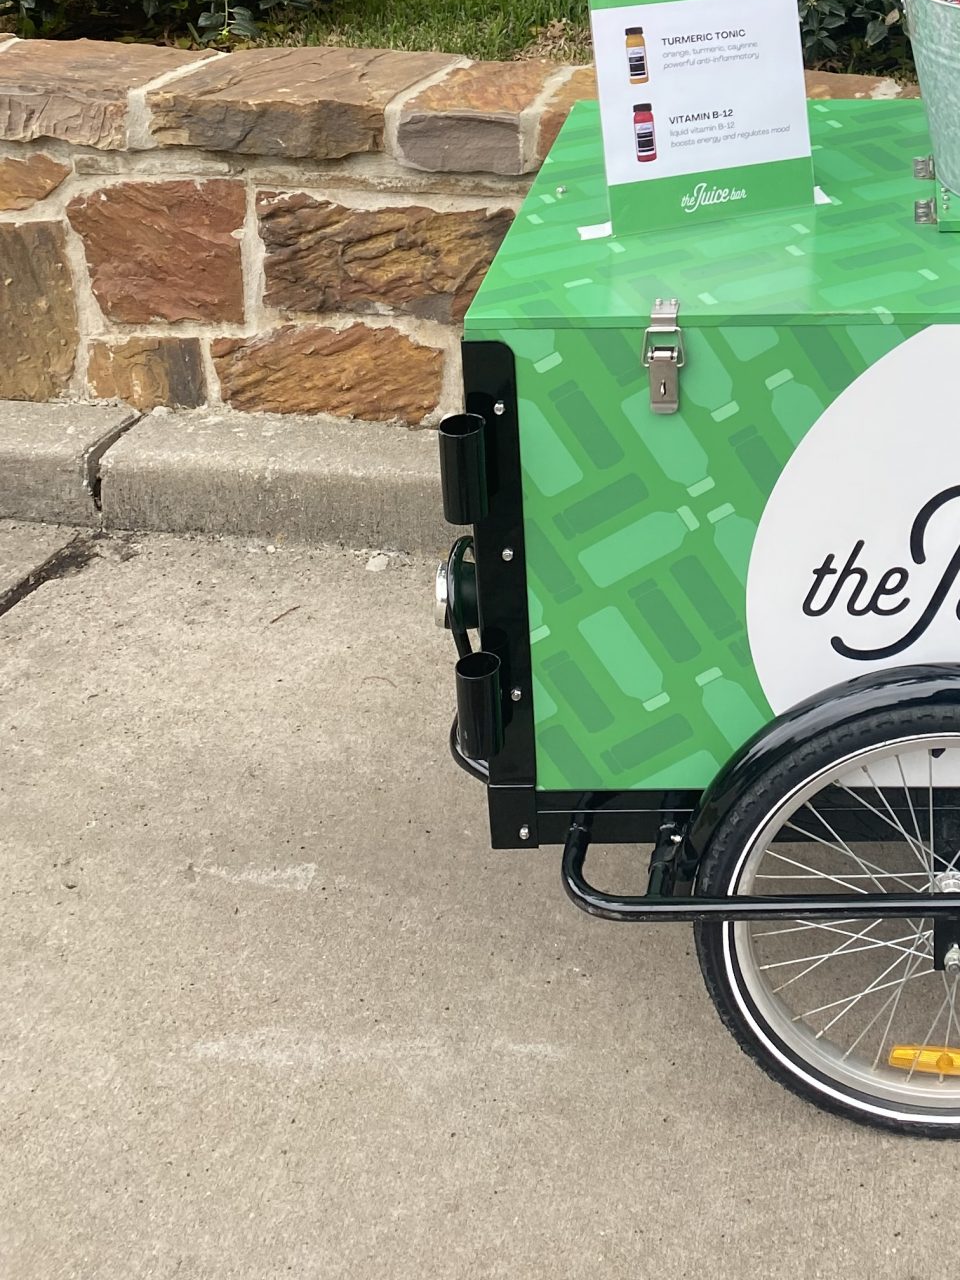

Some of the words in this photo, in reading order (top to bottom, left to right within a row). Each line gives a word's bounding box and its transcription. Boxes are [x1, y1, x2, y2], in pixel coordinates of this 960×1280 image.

[661, 32, 714, 46] TURMERIC
[714, 28, 746, 40] TONIC
[662, 49, 691, 59] orange,
[691, 45, 726, 55] turmeric,
[727, 41, 758, 51] cayenne
[663, 58, 696, 70] powerful
[696, 51, 760, 65] anti-inflammatory
[669, 112, 710, 125] VITAMIN
[712, 108, 734, 119] B-12
[670, 127, 689, 138] liquid
[690, 125, 717, 134] vitamin
[717, 121, 735, 131] B-12
[671, 138, 695, 148] boosts
[696, 135, 721, 144] energy
[722, 132, 737, 141] and
[737, 128, 770, 139] regulates
[770, 124, 791, 134] mood
[681, 193, 696, 207] the
[684, 182, 730, 213] Juice
[730, 187, 747, 201] bar
[801, 539, 911, 618] the
